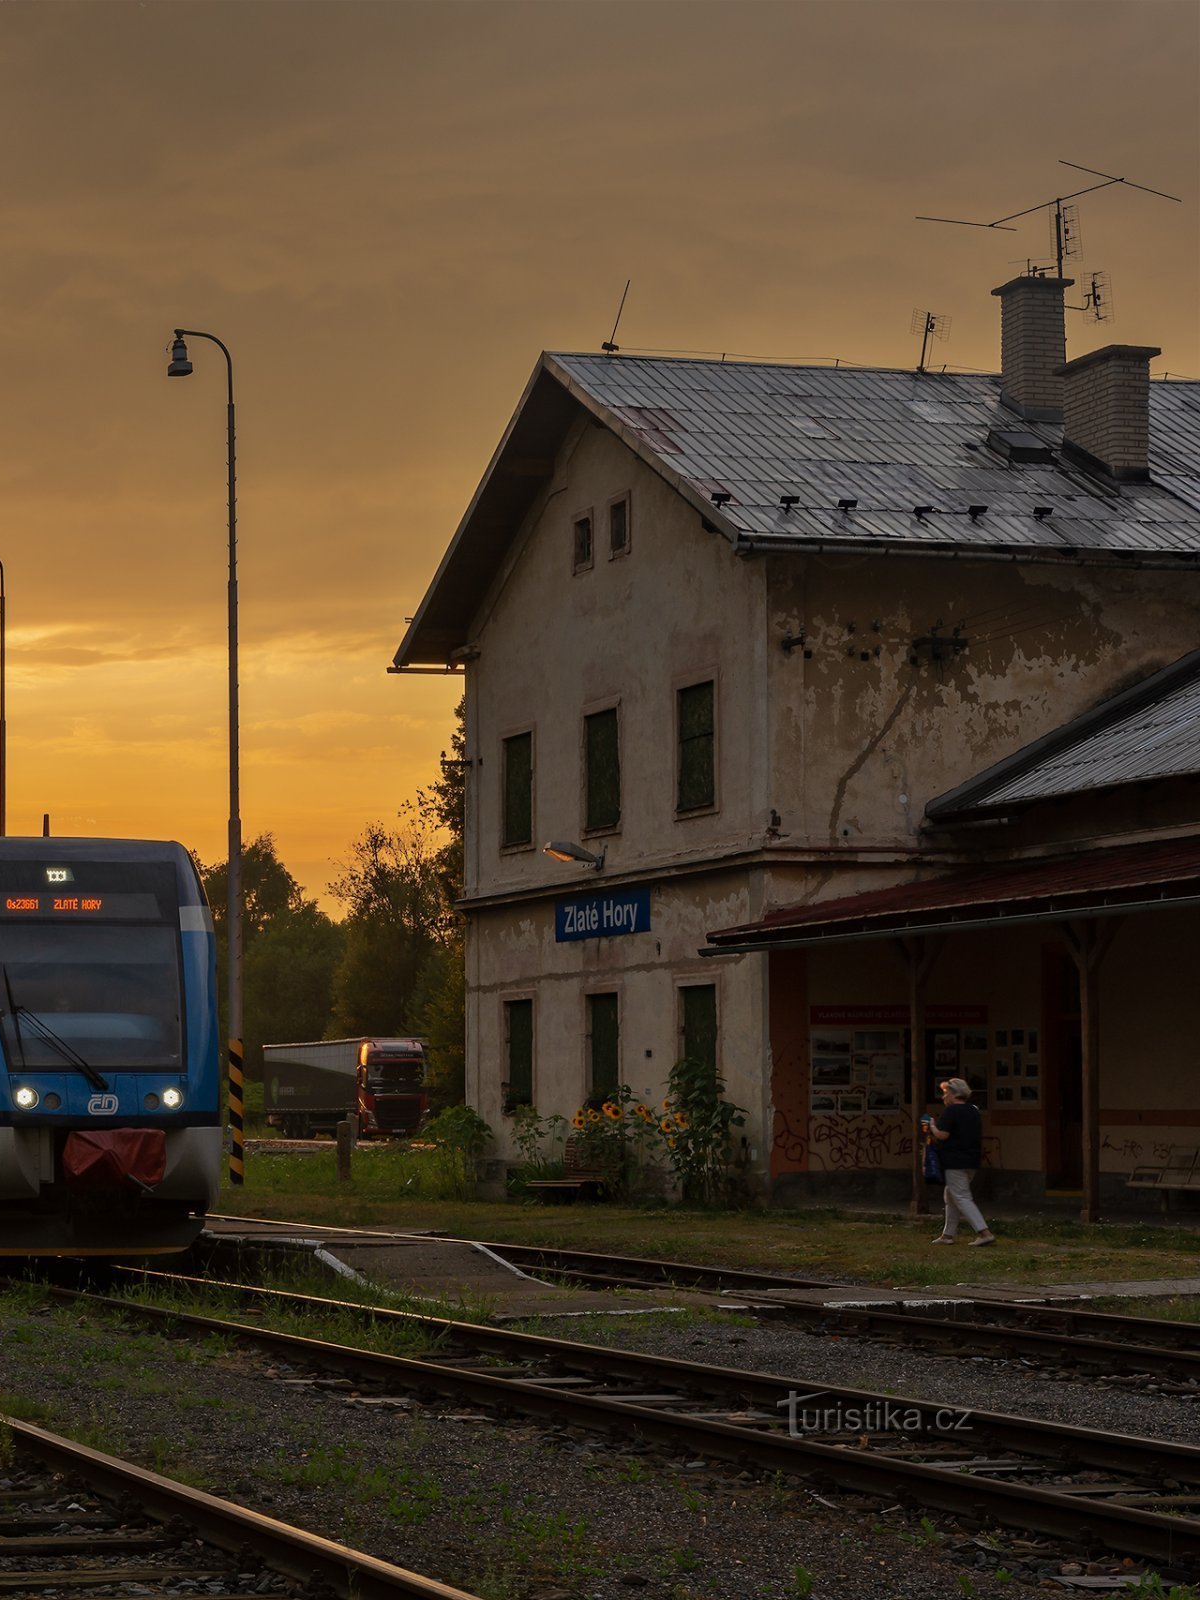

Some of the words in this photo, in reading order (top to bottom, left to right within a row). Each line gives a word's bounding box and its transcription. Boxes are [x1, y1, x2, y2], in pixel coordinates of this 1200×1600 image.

[53, 898, 78, 910] ZLATÉ
[81, 899, 102, 910] HORY
[564, 900, 599, 934] Zlaté
[603, 899, 639, 933] Hory
